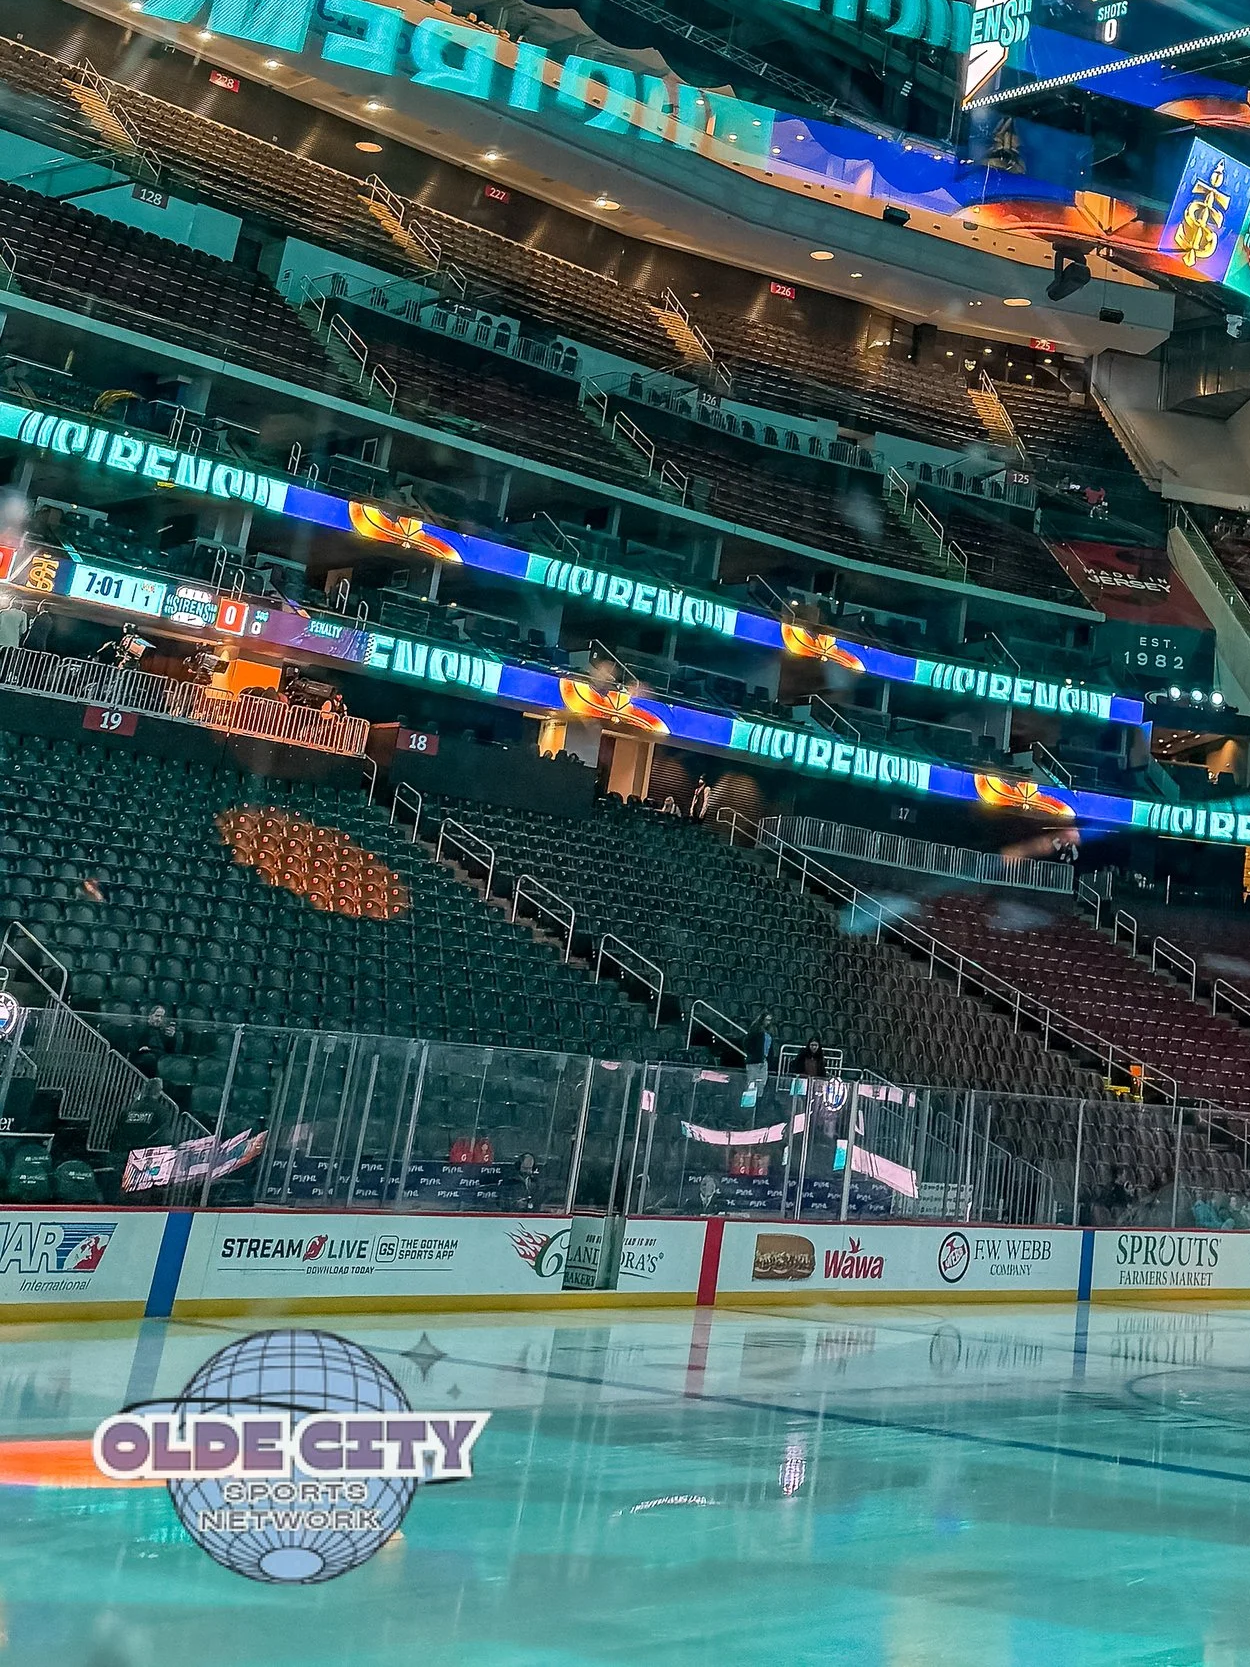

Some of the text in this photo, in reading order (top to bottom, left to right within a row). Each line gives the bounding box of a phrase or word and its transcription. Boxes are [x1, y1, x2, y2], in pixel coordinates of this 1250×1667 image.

[1097, 0, 1129, 22] SHOTS
[1103, 18, 1119, 43] 0
[215, 73, 236, 91] 228
[140, 188, 163, 207] 128
[488, 186, 508, 203] 227
[775, 284, 792, 297] 226
[1034, 339, 1051, 351] 225
[700, 393, 718, 407] 126
[1012, 473, 1030, 485] 125
[1083, 566, 1137, 580] MADE
[85, 571, 124, 600] 7:01
[1087, 574, 1172, 594] JERSEY
[143, 595, 150, 608] 1
[173, 595, 212, 623] SIRENS
[224, 605, 236, 625] 0
[309, 620, 344, 640] PENALTY
[1139, 636, 1177, 650] EST.
[1124, 651, 1185, 670] 1982
[99, 710, 123, 731] 19
[408, 732, 428, 752] 18
[898, 807, 911, 821] 17
[221, 1236, 369, 1260] STREAM LIVE
[377, 1240, 396, 1257] GS
[400, 1238, 459, 1251] THE GOTHAM
[974, 1239, 1002, 1261] F.W.
[1006, 1239, 1052, 1261] WEBB
[1116, 1234, 1220, 1268] SPROUTS
[398, 1249, 455, 1261] SPORTS APP
[306, 1265, 376, 1276] DOWNLOAD TODAY
[824, 1249, 887, 1280] Wawa
[990, 1264, 1033, 1276] COMPANY
[18, 1277, 92, 1293] International
[1119, 1270, 1213, 1288] FARMERS MARKET
